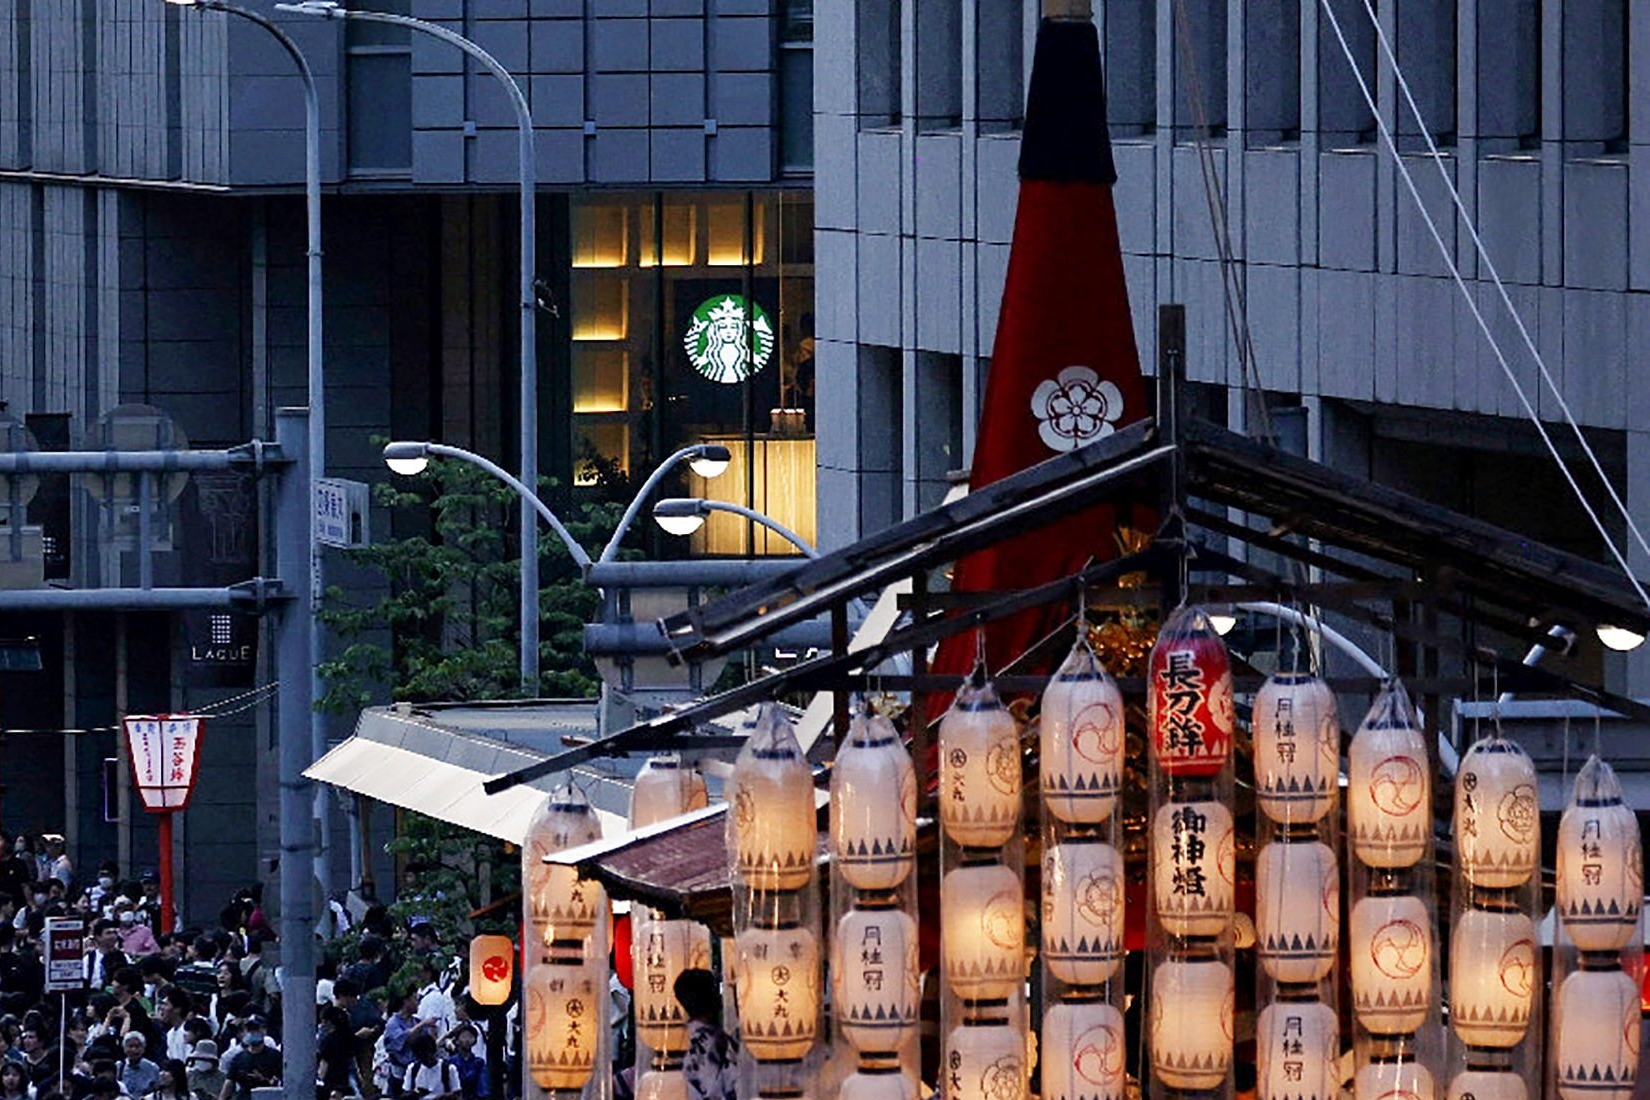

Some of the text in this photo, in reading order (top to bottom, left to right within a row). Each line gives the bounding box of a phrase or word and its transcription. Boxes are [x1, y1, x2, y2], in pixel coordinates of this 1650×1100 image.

[1161, 651, 1204, 756] 長刀鉾
[1275, 697, 1296, 764] 月桂冠
[1580, 820, 1602, 885] 月桂冠
[647, 932, 667, 994] 月桂冠
[861, 925, 885, 992] 月桂冠
[1283, 1016, 1304, 1082] 月桂冠
